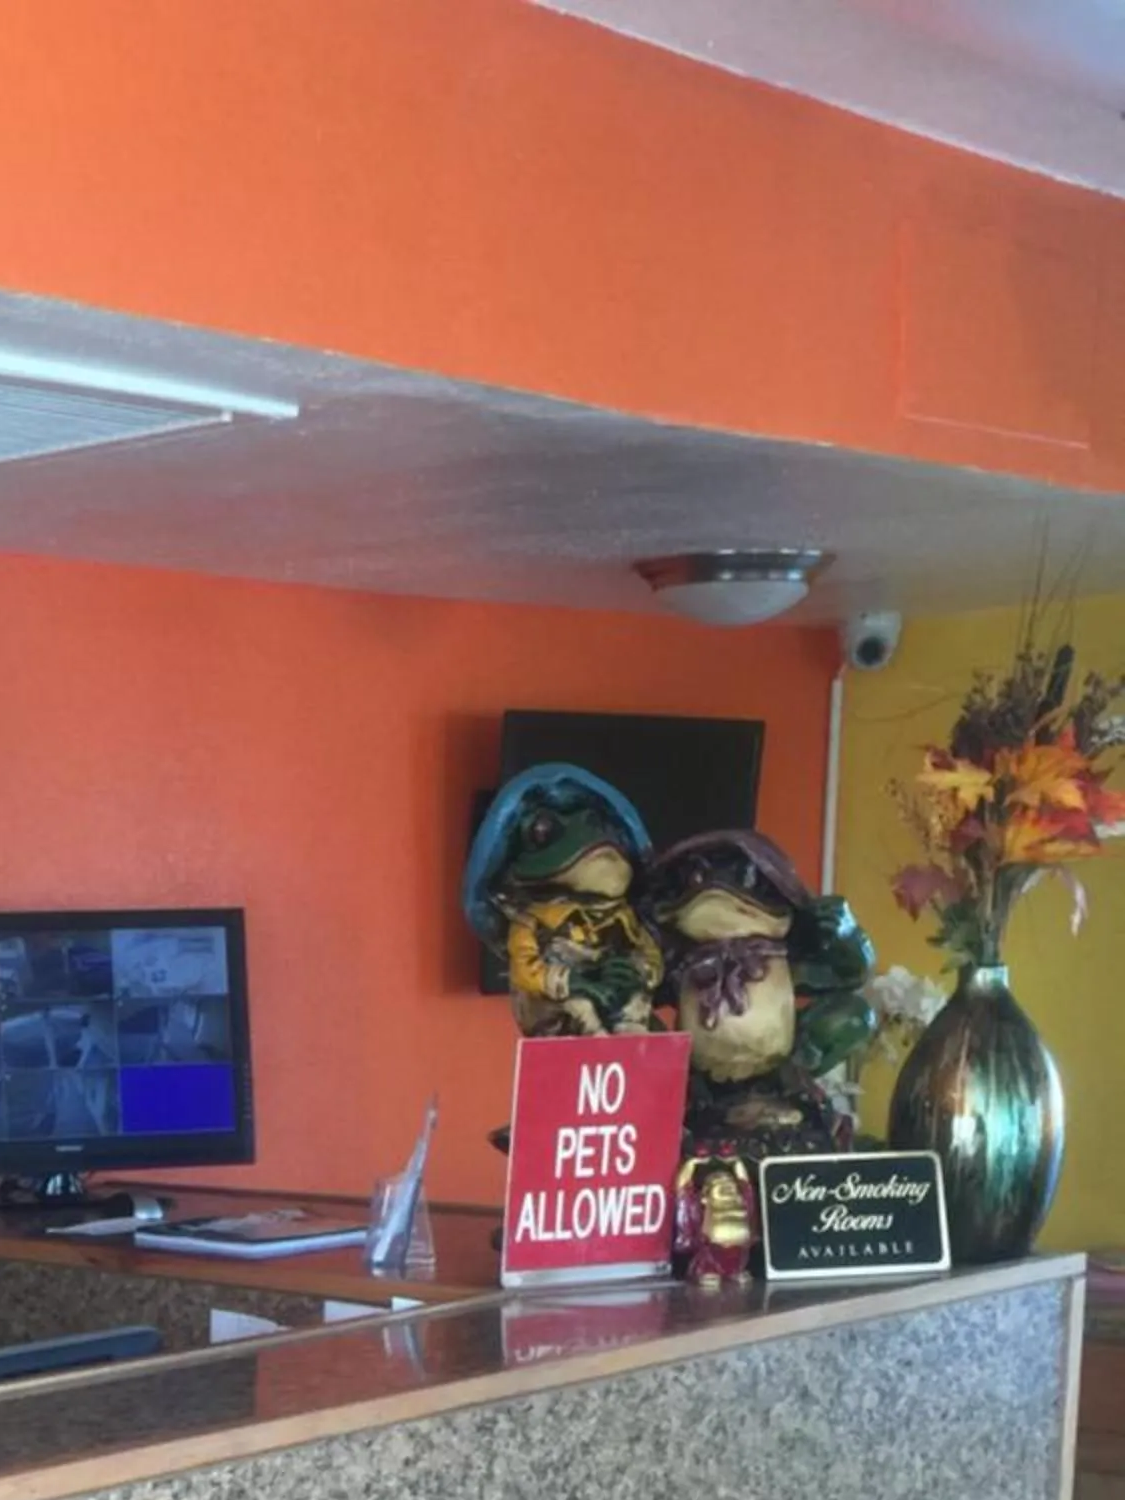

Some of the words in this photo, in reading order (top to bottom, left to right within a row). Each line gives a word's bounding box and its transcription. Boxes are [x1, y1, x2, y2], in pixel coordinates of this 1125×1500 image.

[577, 1062, 626, 1115] NO
[555, 1123, 637, 1179] PETS
[771, 1172, 931, 1206] Non-Smoking
[515, 1184, 666, 1242] ALLOWED
[811, 1203, 894, 1233] Rooms
[797, 1240, 914, 1259] AVAILABLE
